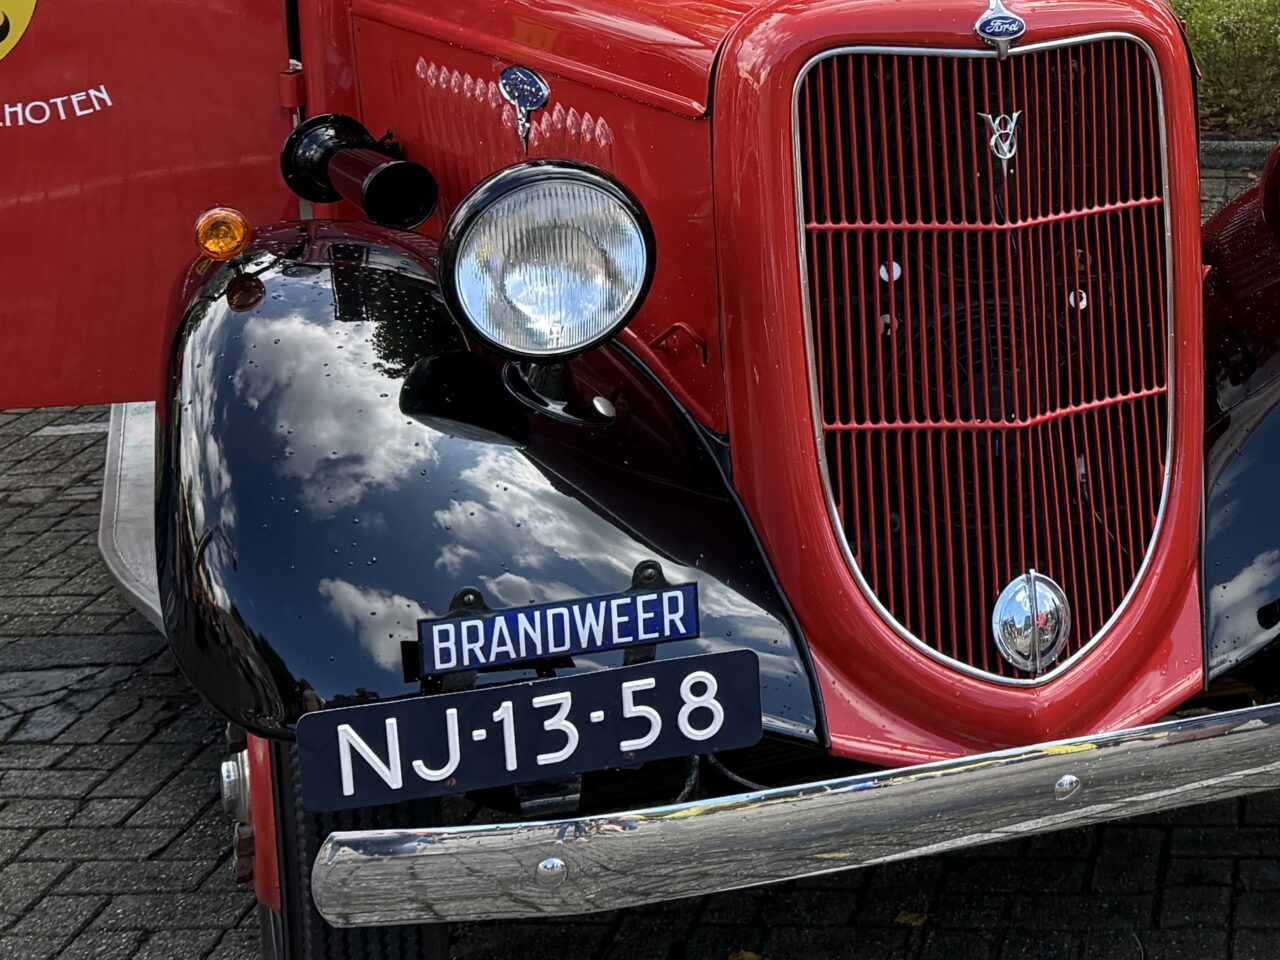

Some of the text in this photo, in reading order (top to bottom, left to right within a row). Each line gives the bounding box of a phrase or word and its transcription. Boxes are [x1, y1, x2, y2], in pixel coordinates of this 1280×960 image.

[985, 18, 1020, 33] Ford
[0, 84, 113, 127] HOTEN
[432, 590, 686, 670] BRANDWEER
[336, 670, 725, 797] NJ-13-58
